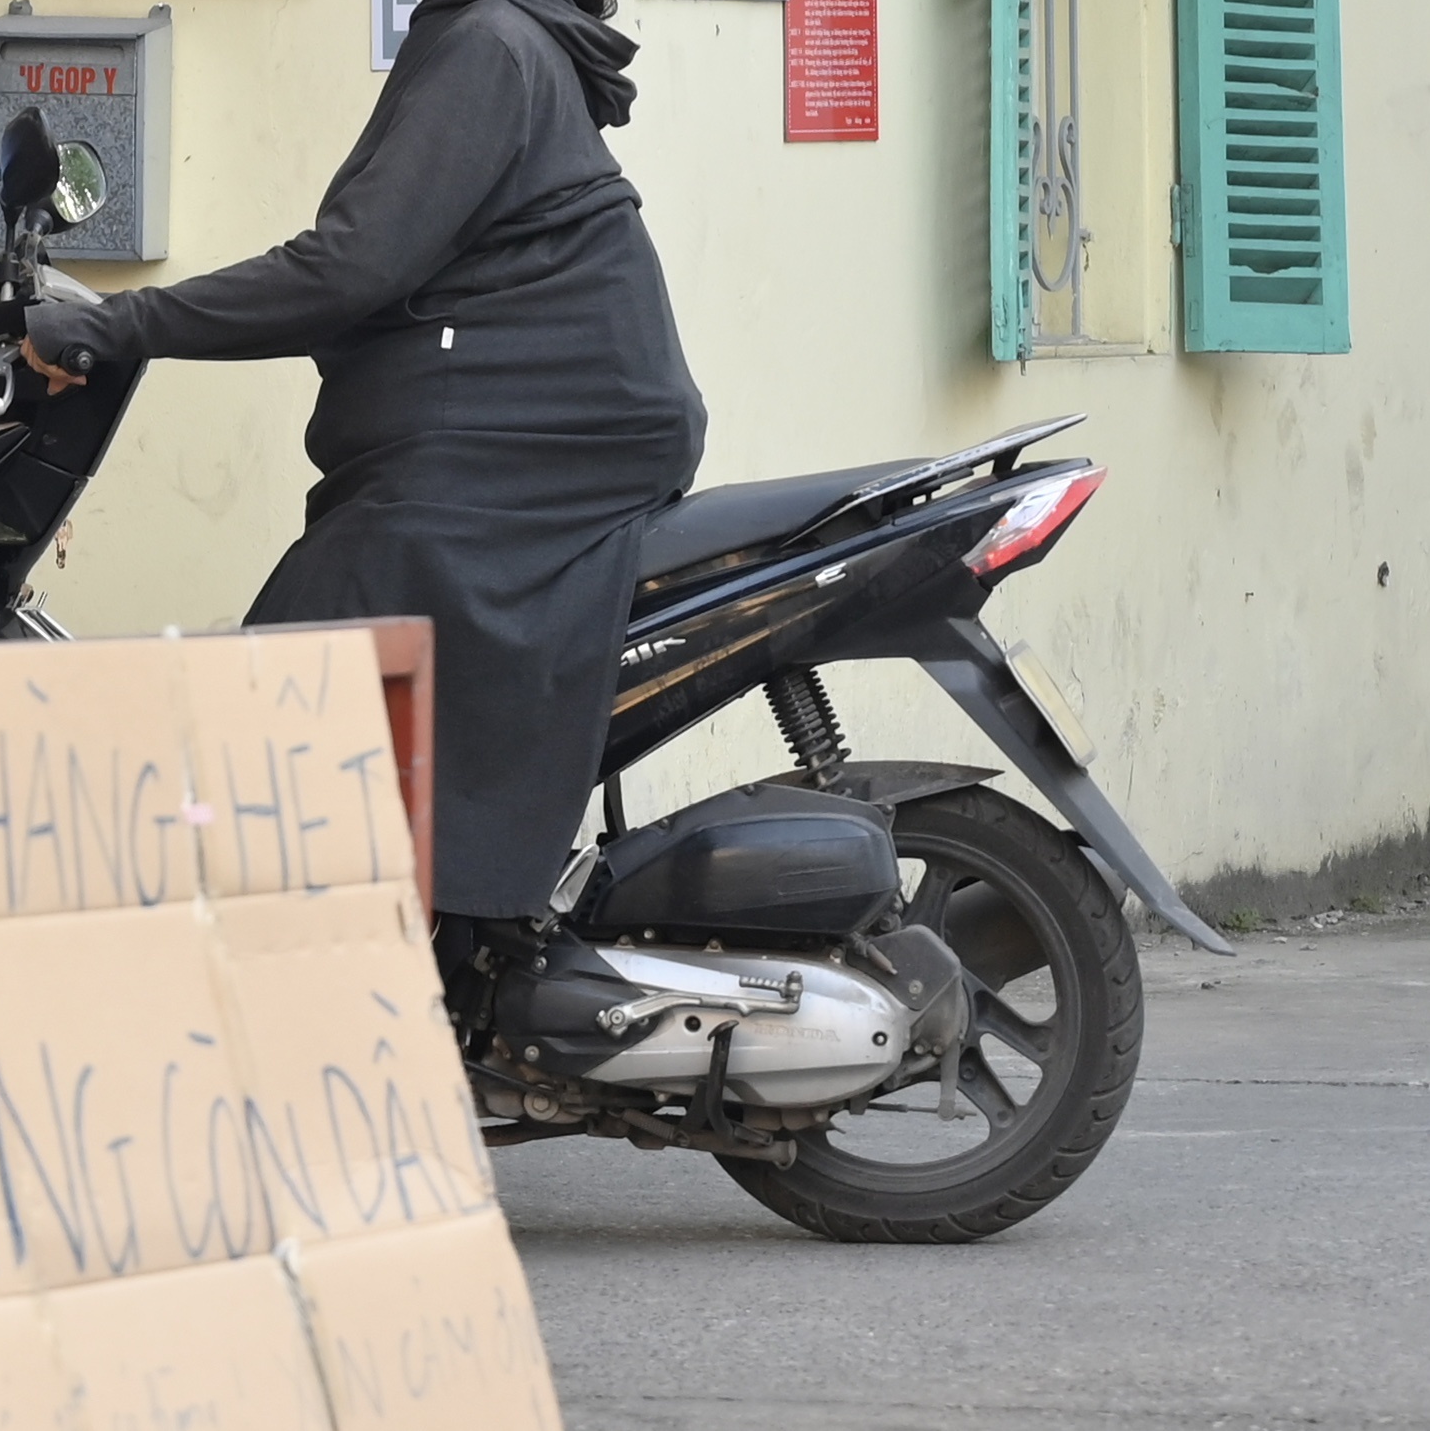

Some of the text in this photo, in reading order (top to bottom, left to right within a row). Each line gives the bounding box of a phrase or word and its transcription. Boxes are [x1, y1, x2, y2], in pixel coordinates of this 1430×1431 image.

[103, 67, 117, 95] Y
[224, 643, 385, 898] HẾT
[162, 1031, 326, 1262] CÒN
